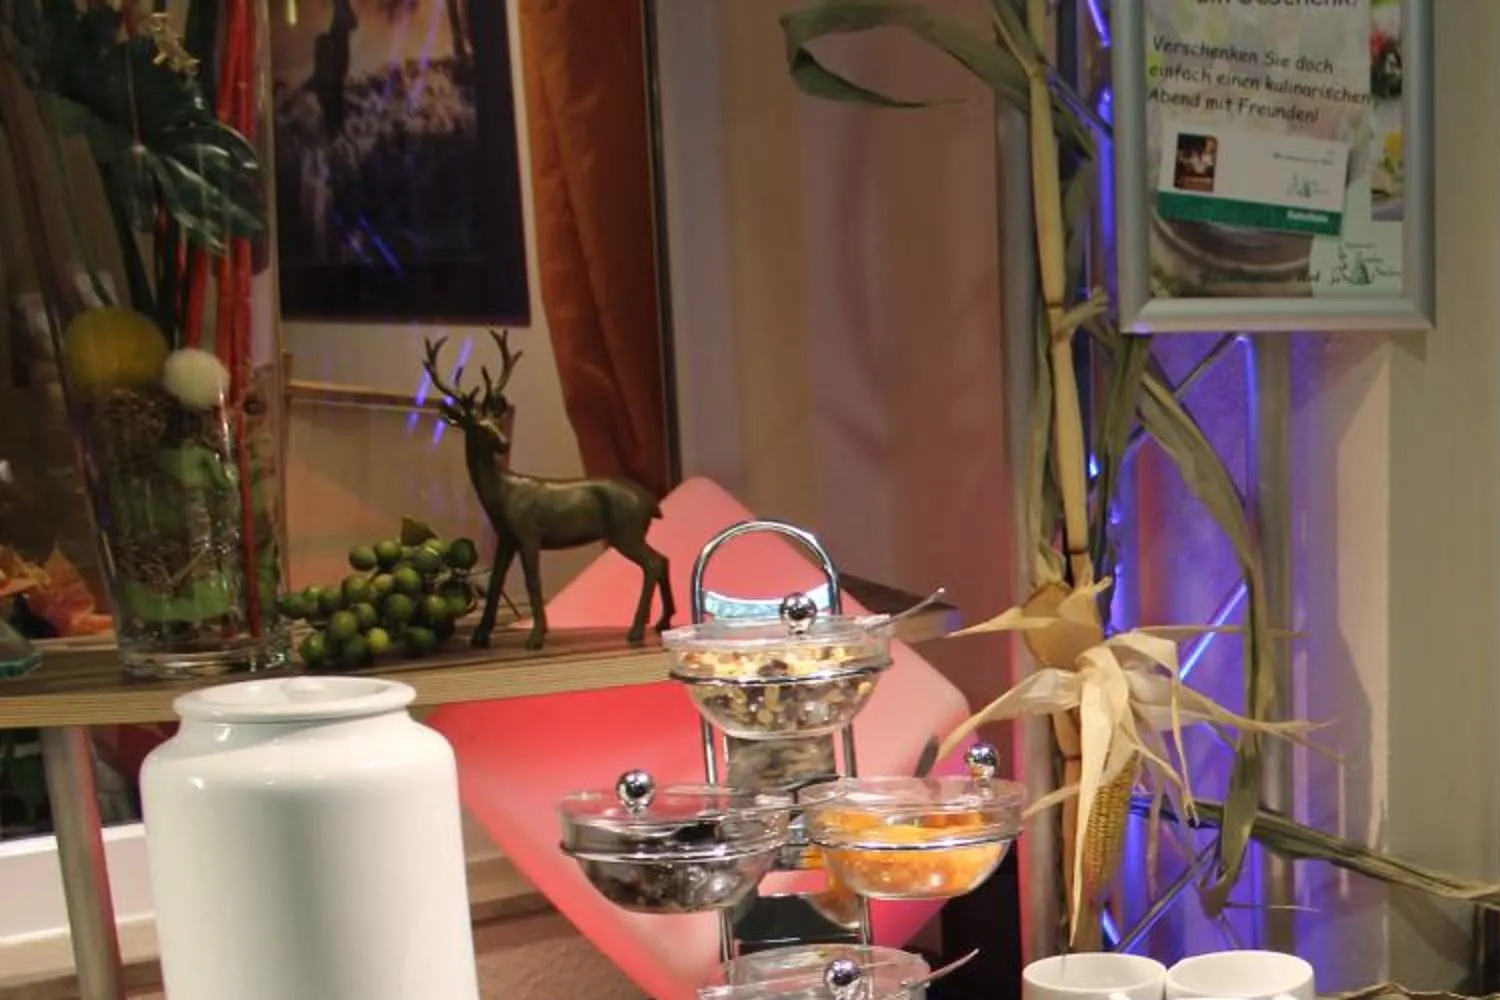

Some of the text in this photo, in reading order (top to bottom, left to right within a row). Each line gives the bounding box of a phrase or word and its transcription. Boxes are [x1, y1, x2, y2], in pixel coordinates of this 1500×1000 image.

[1153, 36, 1334, 74] Verschenken Sie doch
[1148, 63, 1372, 104] einfach einen kulinarischen
[1148, 88, 1320, 123] Abend mit Freunden!
